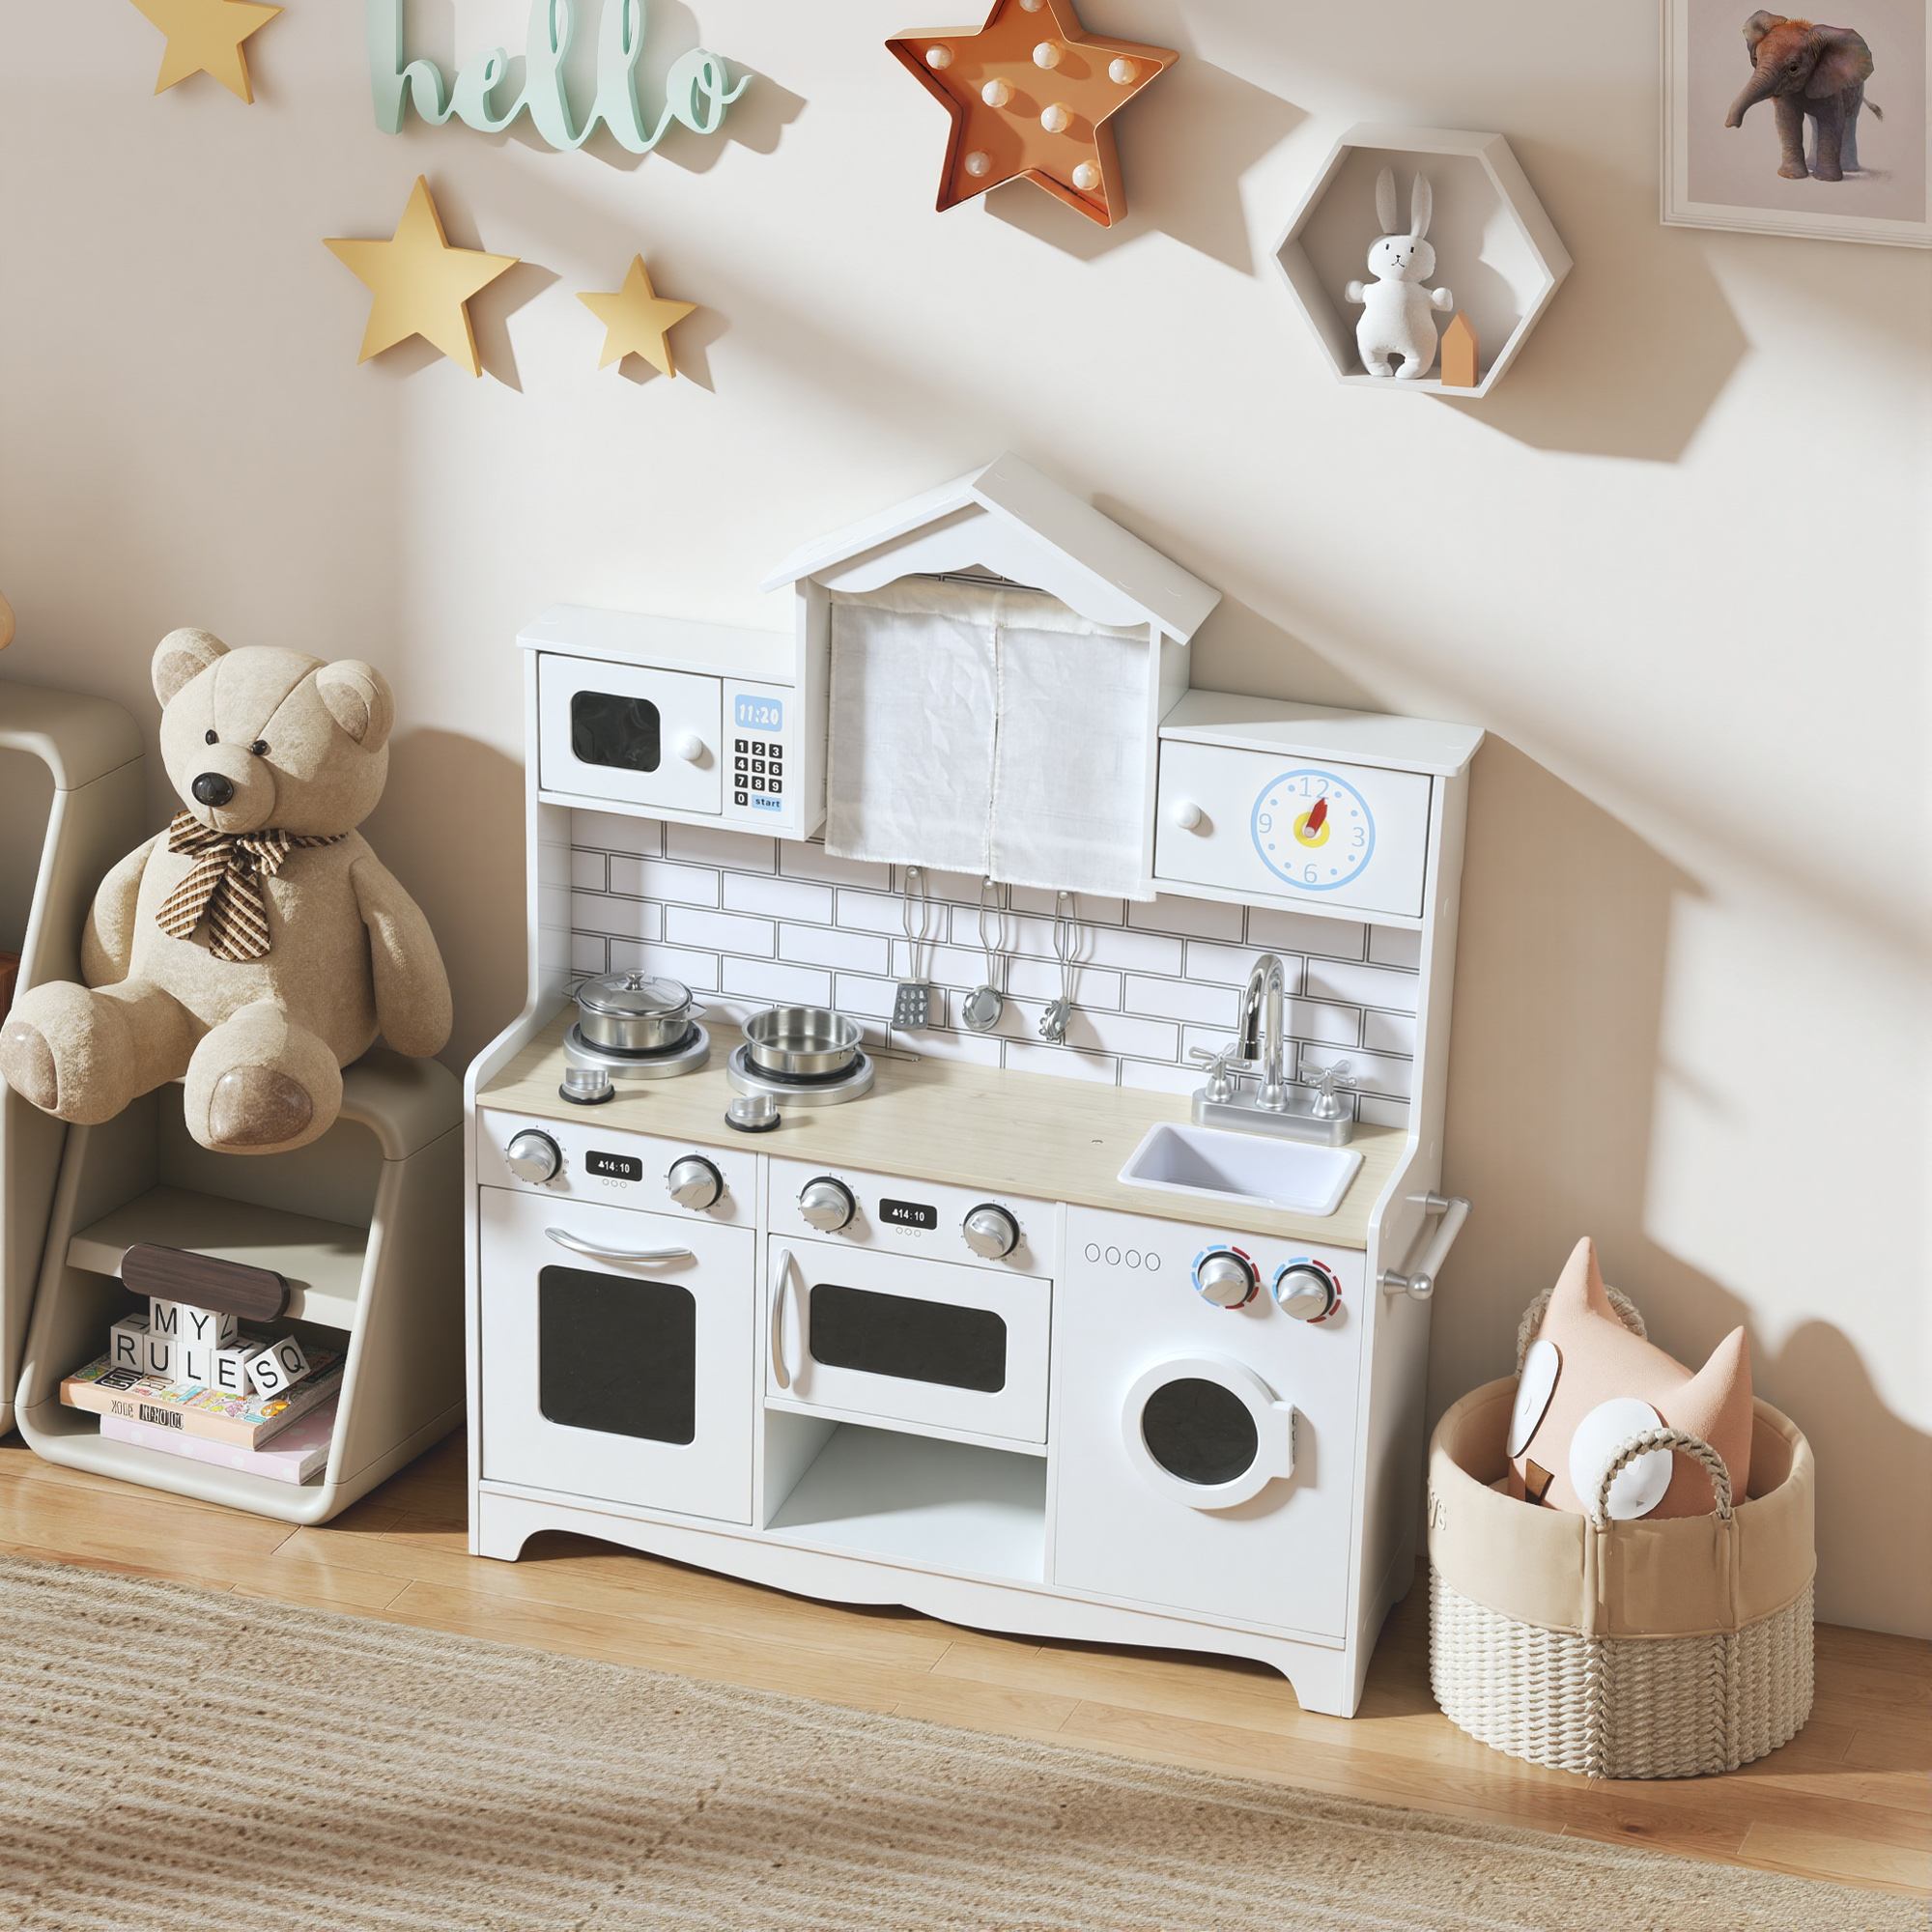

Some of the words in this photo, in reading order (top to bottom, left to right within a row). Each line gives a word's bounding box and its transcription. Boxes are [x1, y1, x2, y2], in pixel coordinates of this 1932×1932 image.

[364, 0, 753, 154] hello
[739, 703, 780, 725] 11:20
[738, 741, 745, 753] 1
[754, 744, 763, 754] 2
[772, 746, 780, 757] 3
[737, 758, 746, 770] 4
[754, 761, 763, 772] 5
[772, 764, 780, 775] 6
[737, 776, 745, 786] 7
[754, 779, 763, 789] 8
[772, 781, 780, 792] 9
[1299, 776, 1330, 800] 12
[737, 793, 745, 804] 0
[754, 797, 781, 809] start
[1258, 812, 1273, 834] 9
[1350, 826, 1366, 848] 3
[1303, 863, 1319, 884] 6
